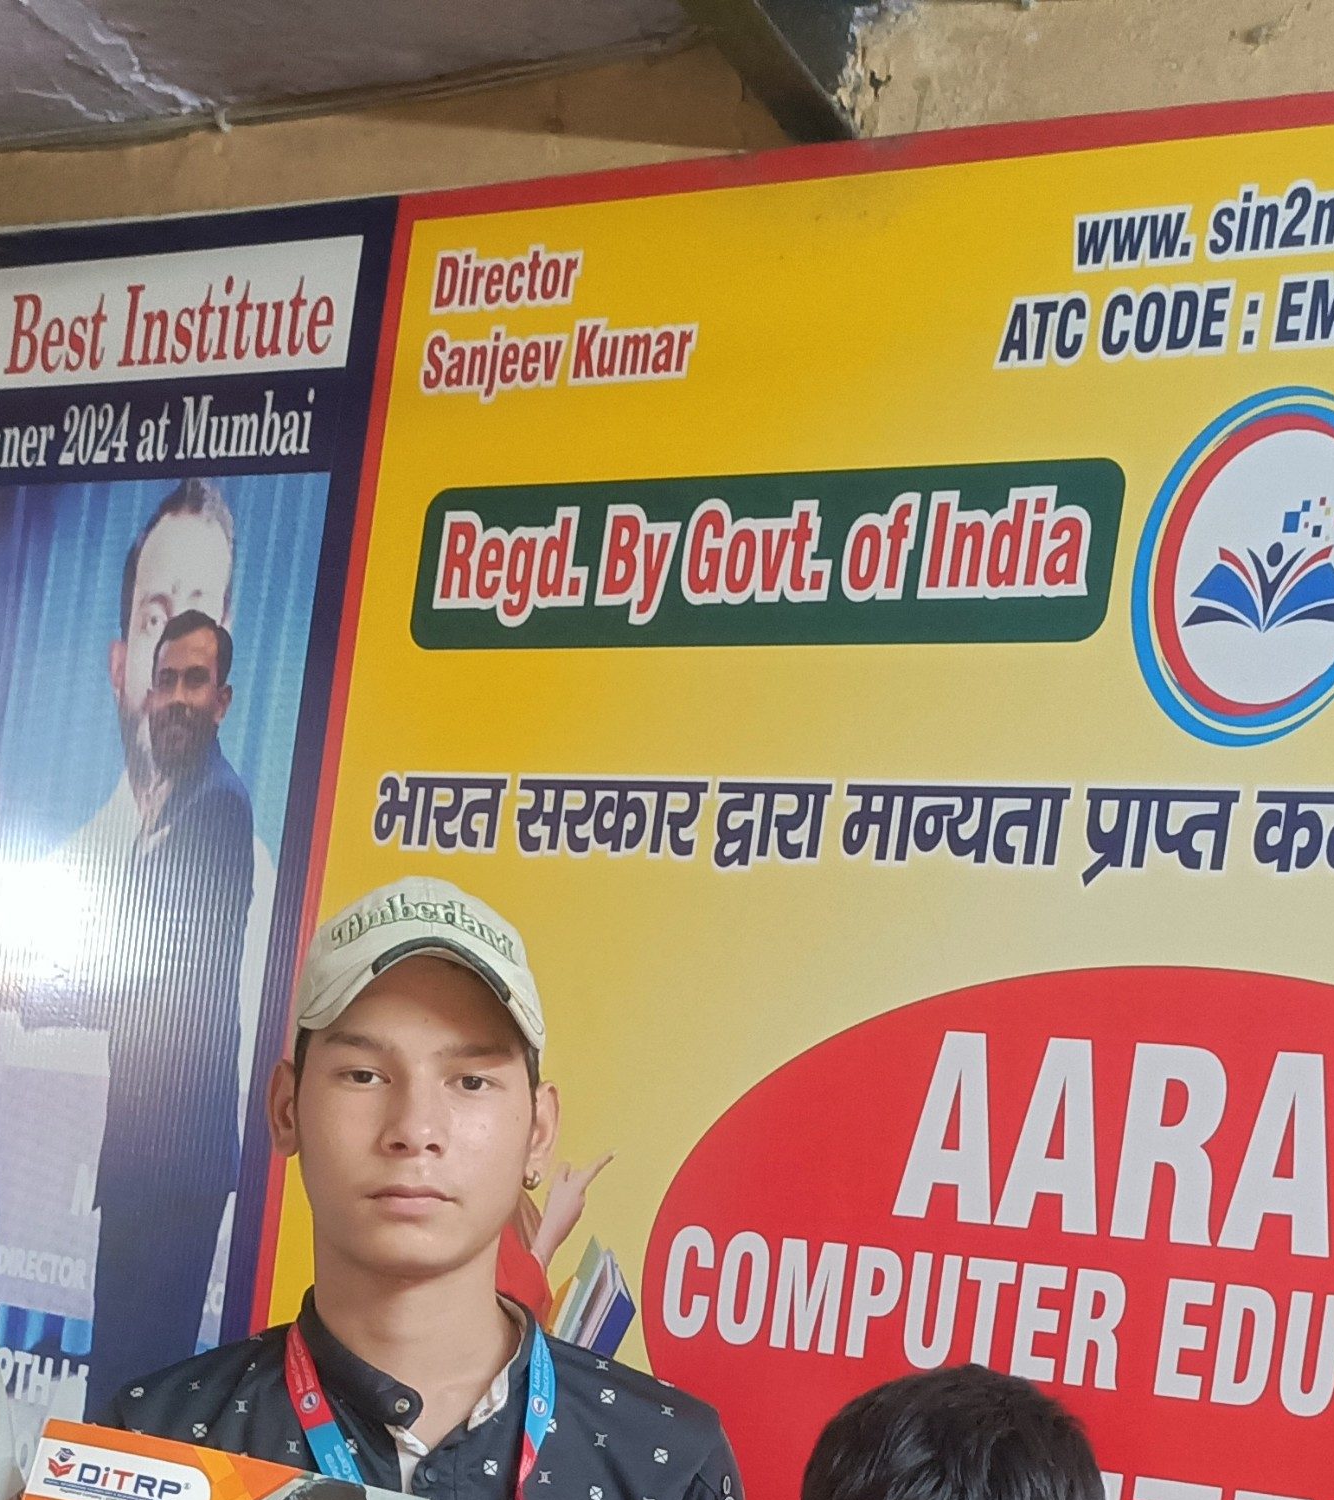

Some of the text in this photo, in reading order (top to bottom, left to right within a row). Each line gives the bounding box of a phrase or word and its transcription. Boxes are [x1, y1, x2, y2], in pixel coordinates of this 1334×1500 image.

[1076, 211, 1191, 266] www.
[433, 249, 579, 309] Director
[5, 293, 107, 376] Best
[117, 275, 334, 368] Institute
[423, 322, 695, 398] Sanjeev Kumar
[999, 296, 1086, 362] ATC
[1101, 286, 1230, 355] CODE
[1246, 300, 1259, 346] :
[59, 402, 129, 465] 2024
[135, 402, 170, 462] at
[175, 388, 316, 460] Mumbai
[439, 497, 1085, 618] Regd. By Govt. of India
[373, 773, 508, 850] भारत
[516, 777, 709, 857] सरकार
[714, 781, 833, 867] द्वारा
[842, 783, 1071, 866] मान्यता
[1082, 787, 1240, 886] प्राप्त
[331, 894, 517, 964] Timberland
[661, 1225, 1128, 1391] COMPUTER
